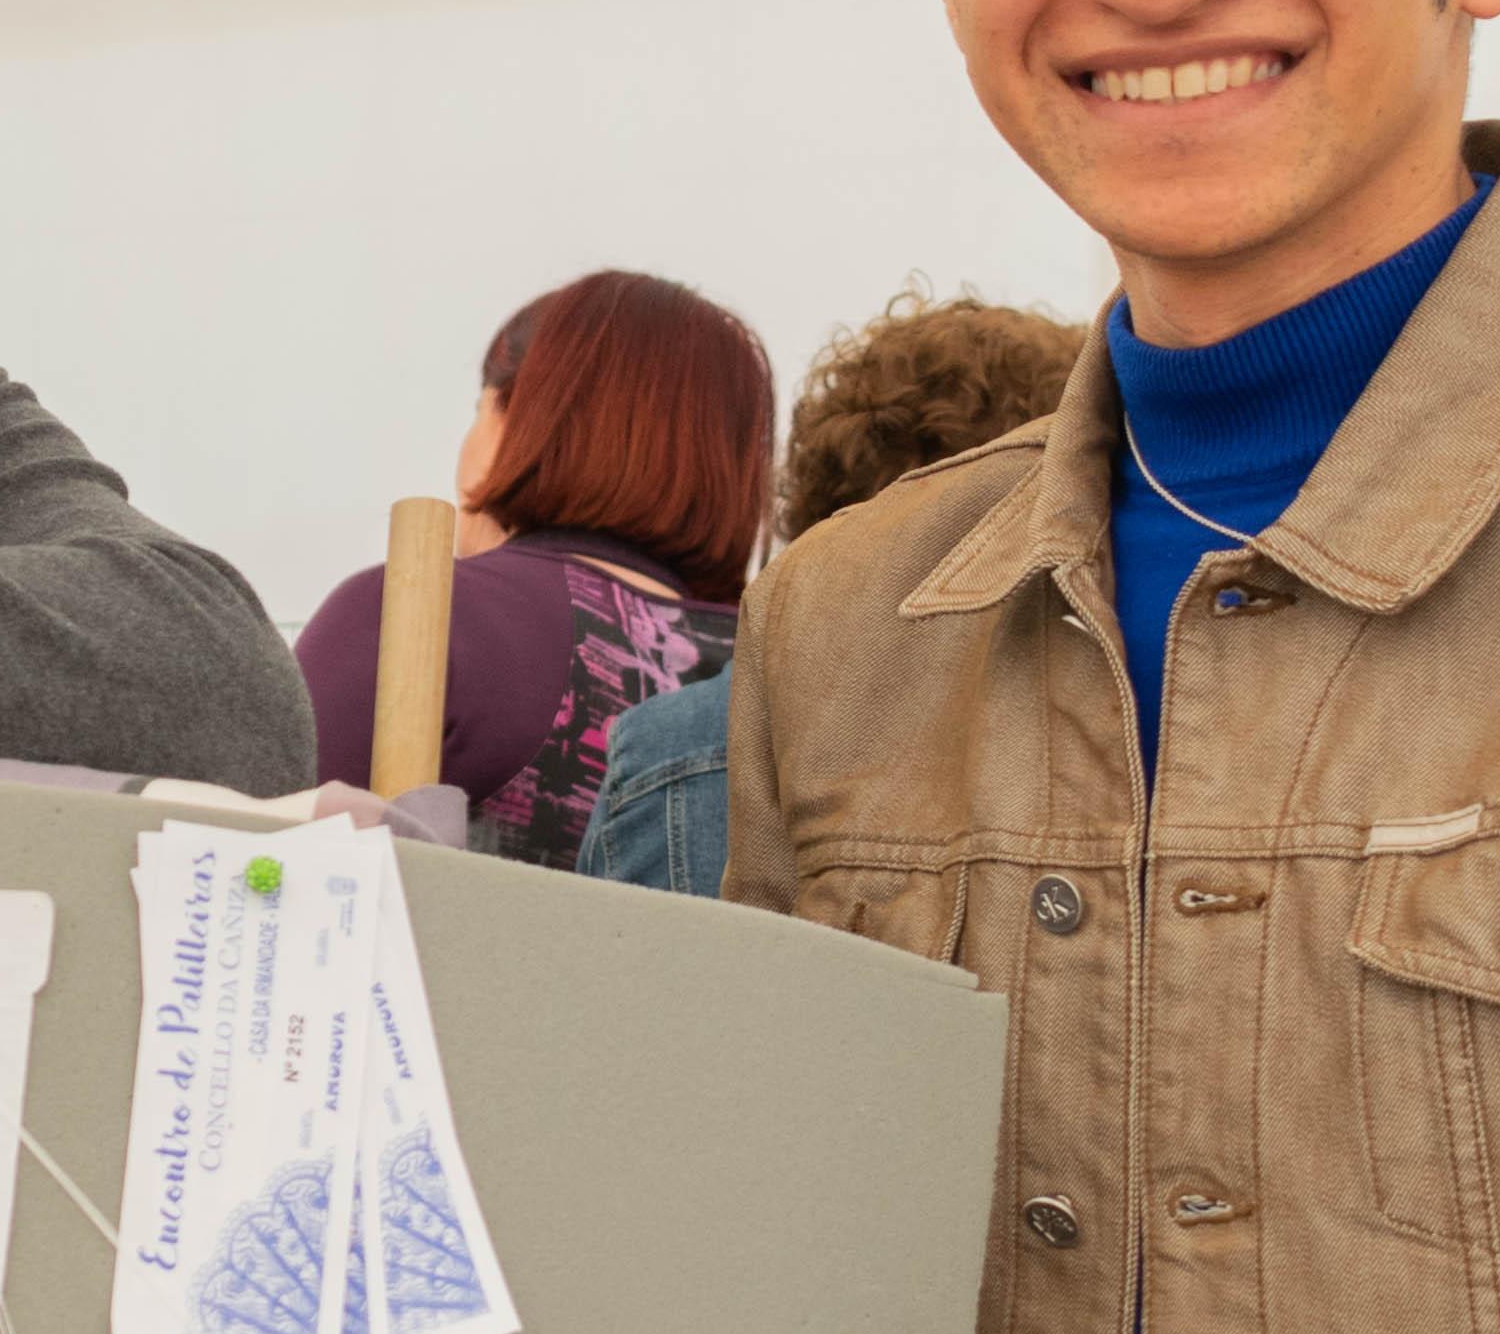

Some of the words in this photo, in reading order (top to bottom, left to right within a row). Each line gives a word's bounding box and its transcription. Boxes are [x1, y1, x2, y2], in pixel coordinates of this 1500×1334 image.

[156, 847, 216, 1034] Palilleiras
[254, 922, 280, 996] IRMANDADE
[252, 999, 272, 1018] DA
[248, 1020, 270, 1055] CASA
[286, 1013, 305, 1057] 2152
[157, 1048, 197, 1090] de
[136, 1104, 191, 1270] Encontro
